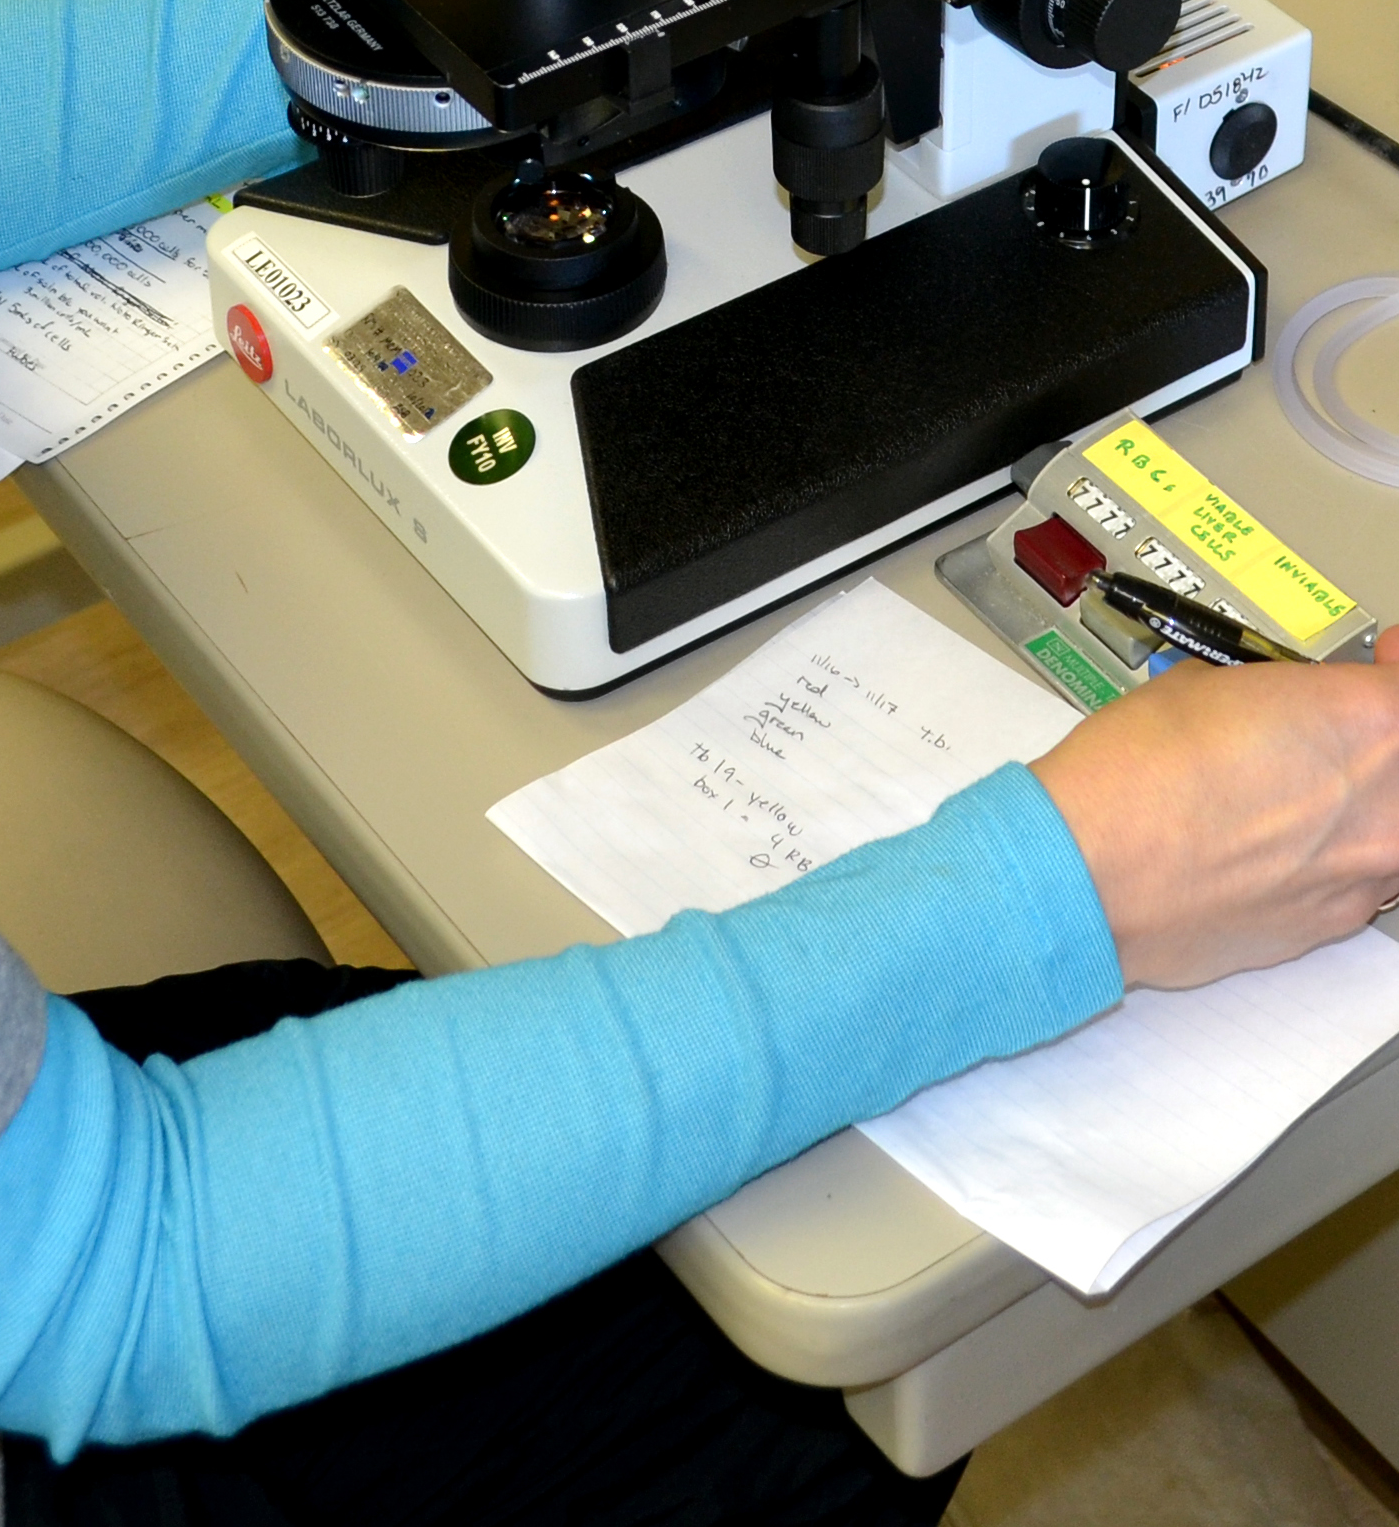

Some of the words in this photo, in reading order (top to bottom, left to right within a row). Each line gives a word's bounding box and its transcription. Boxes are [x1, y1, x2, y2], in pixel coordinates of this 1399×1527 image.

[347, 19, 384, 52] GERMANY
[1205, 185, 1227, 207] 39
[243, 248, 312, 314] LE01023
[230, 324, 263, 371] Leitz
[284, 377, 402, 517] LABORLUX
[466, 433, 497, 474] FY10
[492, 426, 518, 453] INV
[1193, 506, 1238, 544] LIVER
[1204, 493, 1255, 536] VIABLE
[1190, 523, 1237, 562] CELLS
[1274, 555, 1347, 617] INVIABLE
[797, 675, 829, 698] red
[1065, 654, 1104, 690] MULTIPLE
[764, 692, 832, 729] yellow
[865, 690, 898, 716] 11/17
[743, 709, 805, 742] green
[750, 728, 787, 761] blue
[693, 776, 719, 800] box
[750, 791, 804, 837] yellow
